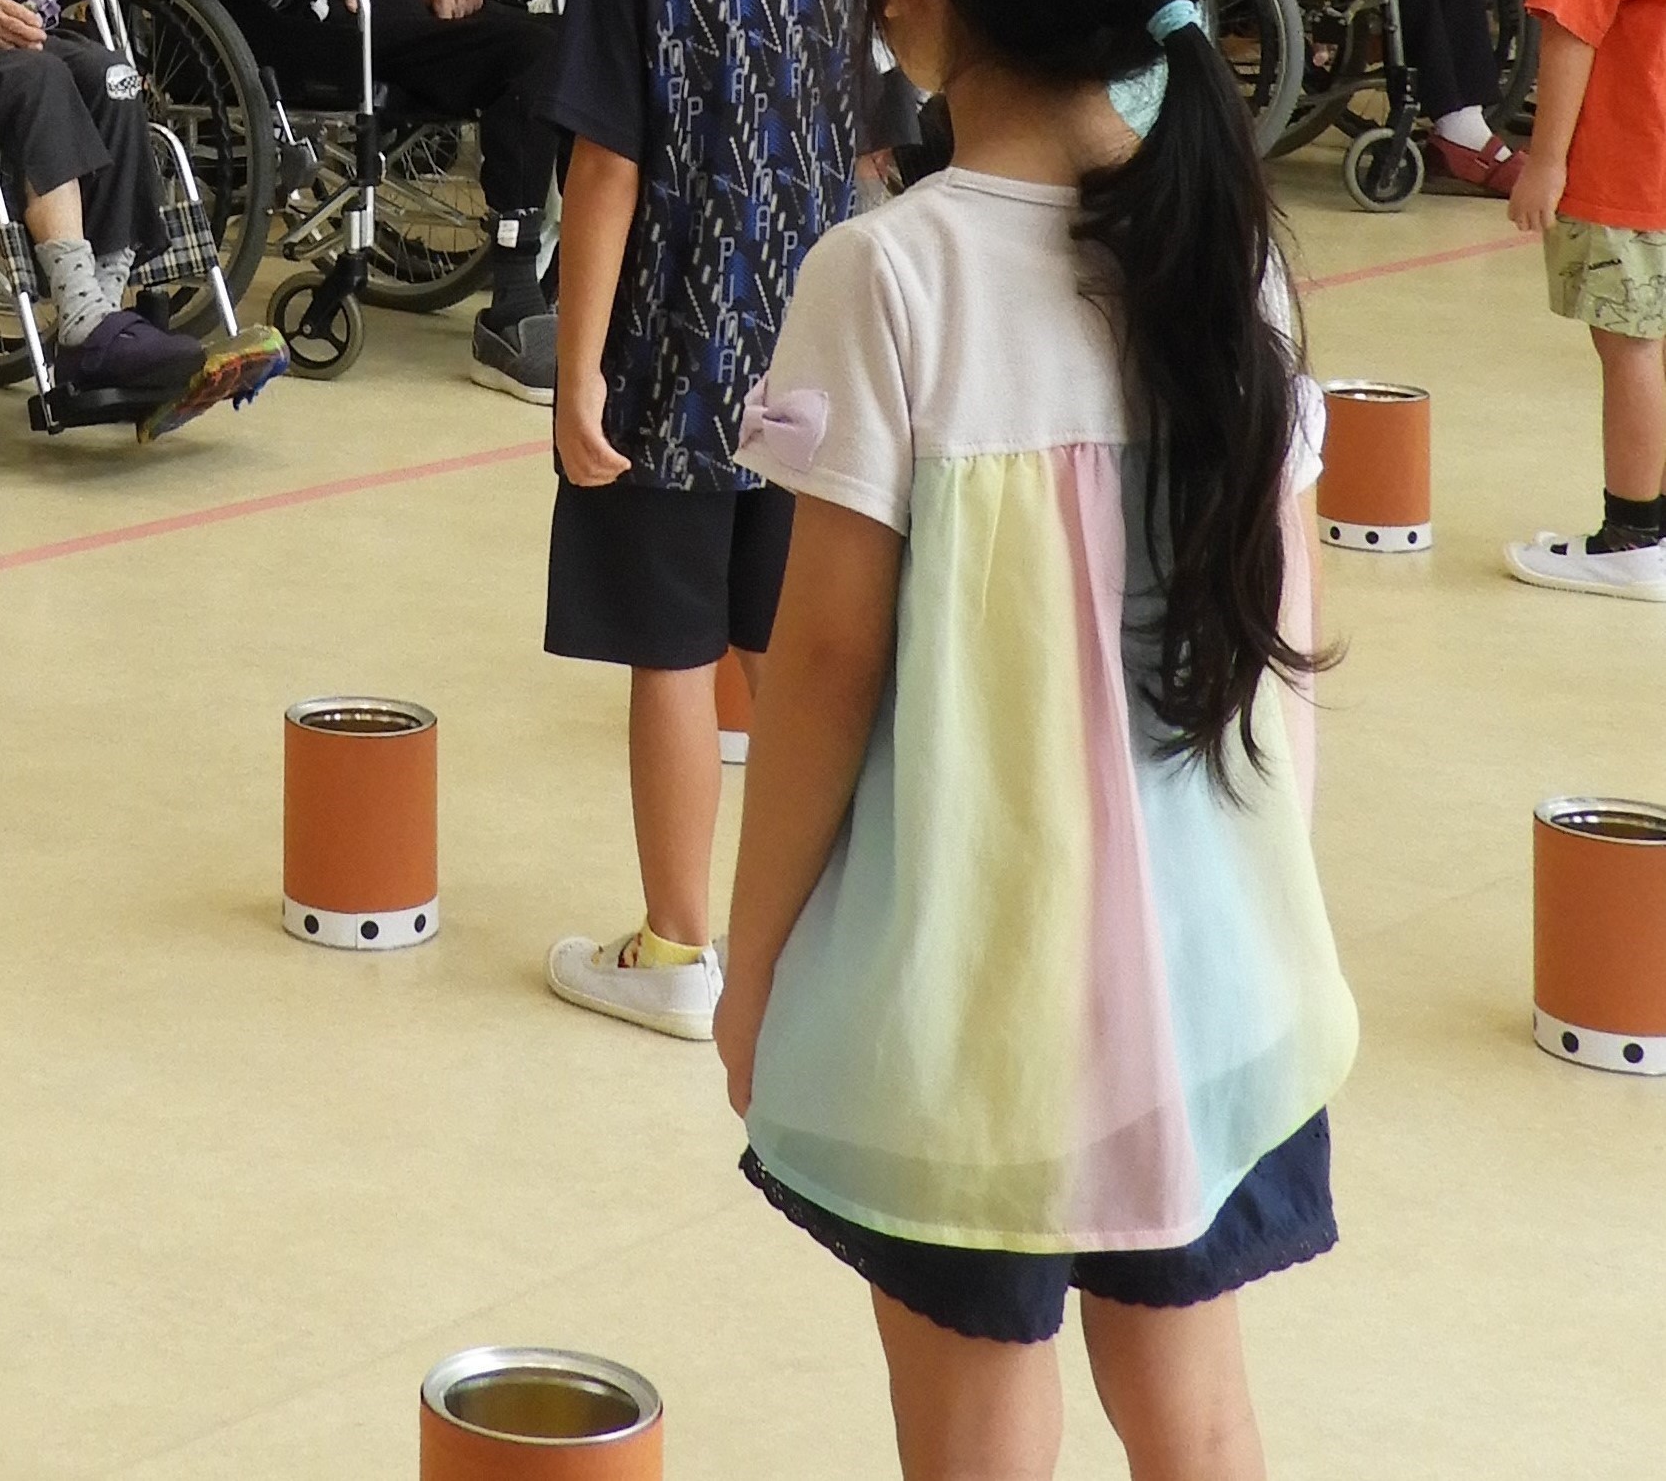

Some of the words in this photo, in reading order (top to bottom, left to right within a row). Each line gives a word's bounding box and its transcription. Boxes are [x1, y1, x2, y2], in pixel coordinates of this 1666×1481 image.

[656, 0, 685, 114] UMA
[751, 92, 773, 242] PUMA
[715, 236, 739, 384] PUMA
[661, 375, 690, 489] PUM
